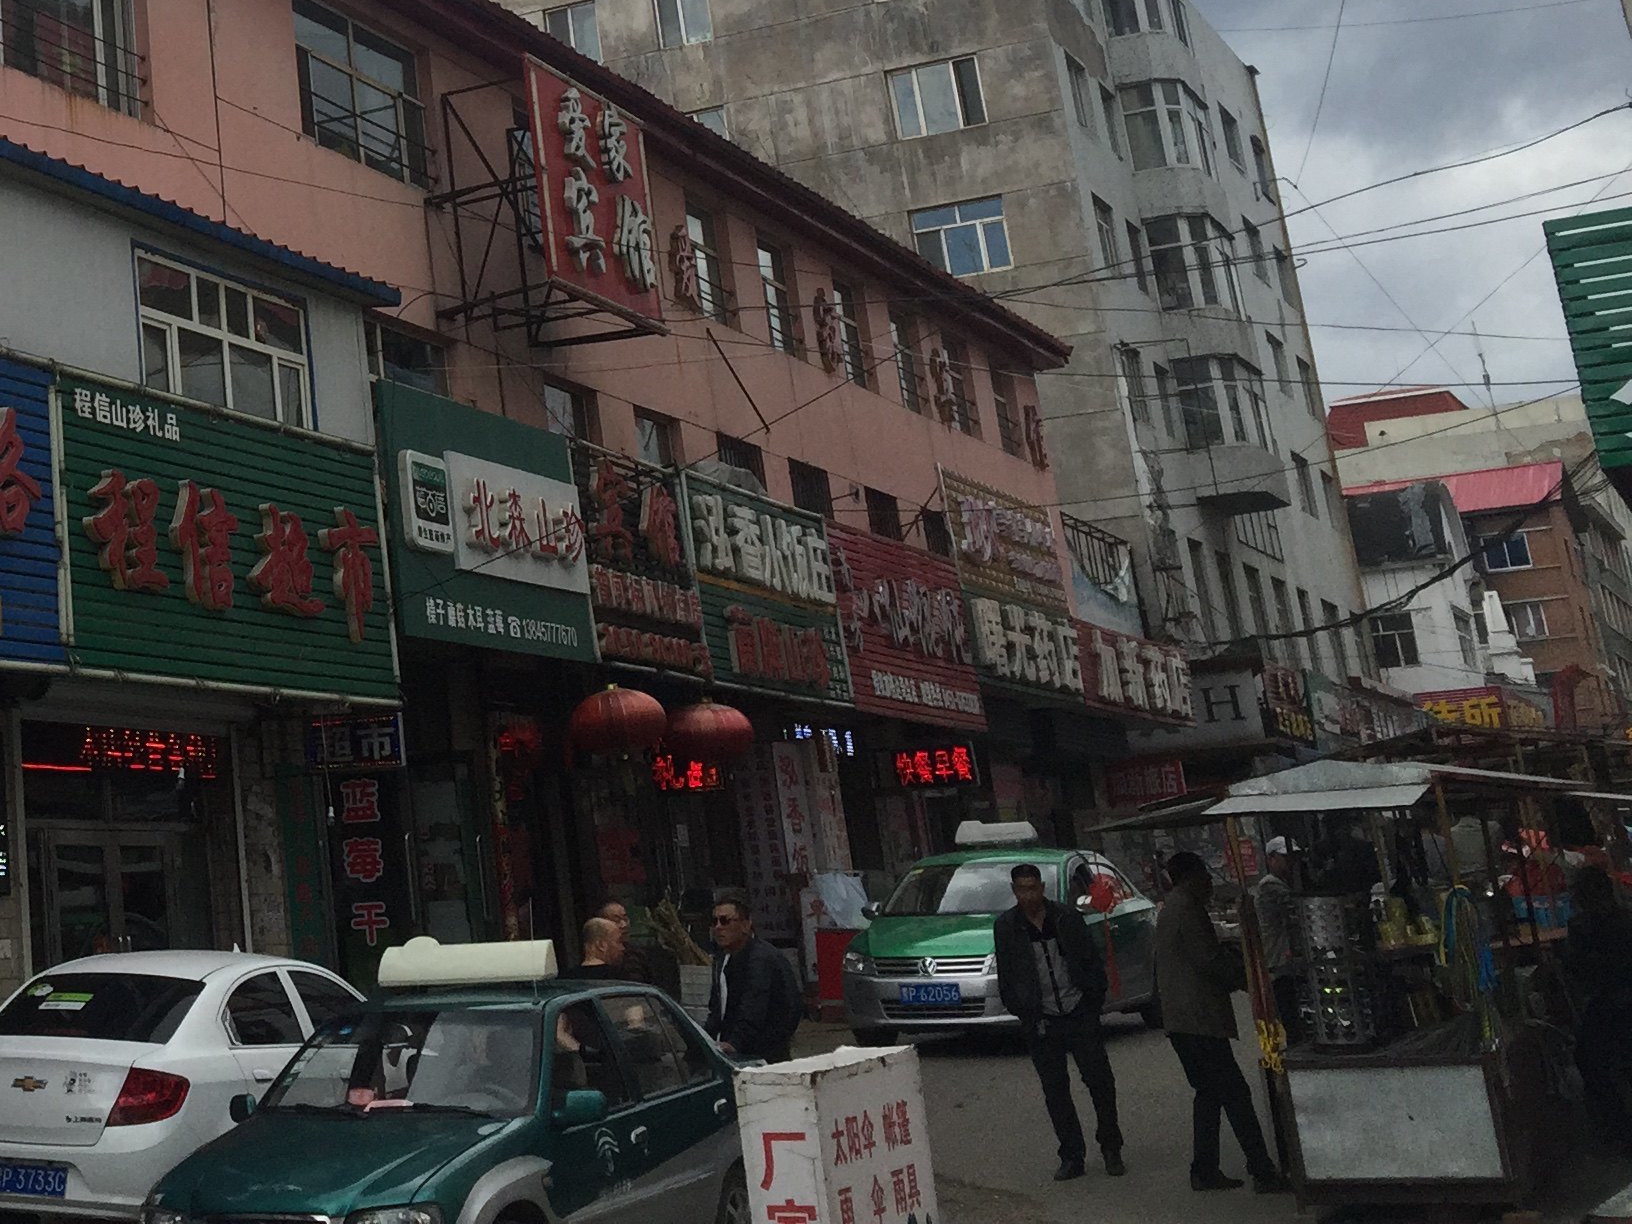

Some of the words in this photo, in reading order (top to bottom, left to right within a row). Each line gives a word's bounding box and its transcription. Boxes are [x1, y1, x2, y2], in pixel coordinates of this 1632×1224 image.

[74, 388, 180, 442] 程信山珍礼品
[82, 469, 378, 642] 程信超市
[469, 477, 587, 564] 北森山珍
[1200, 685, 1247, 723] H
[340, 778, 390, 946] 蓝莓干
[832, 1109, 876, 1166] 太阳伞
